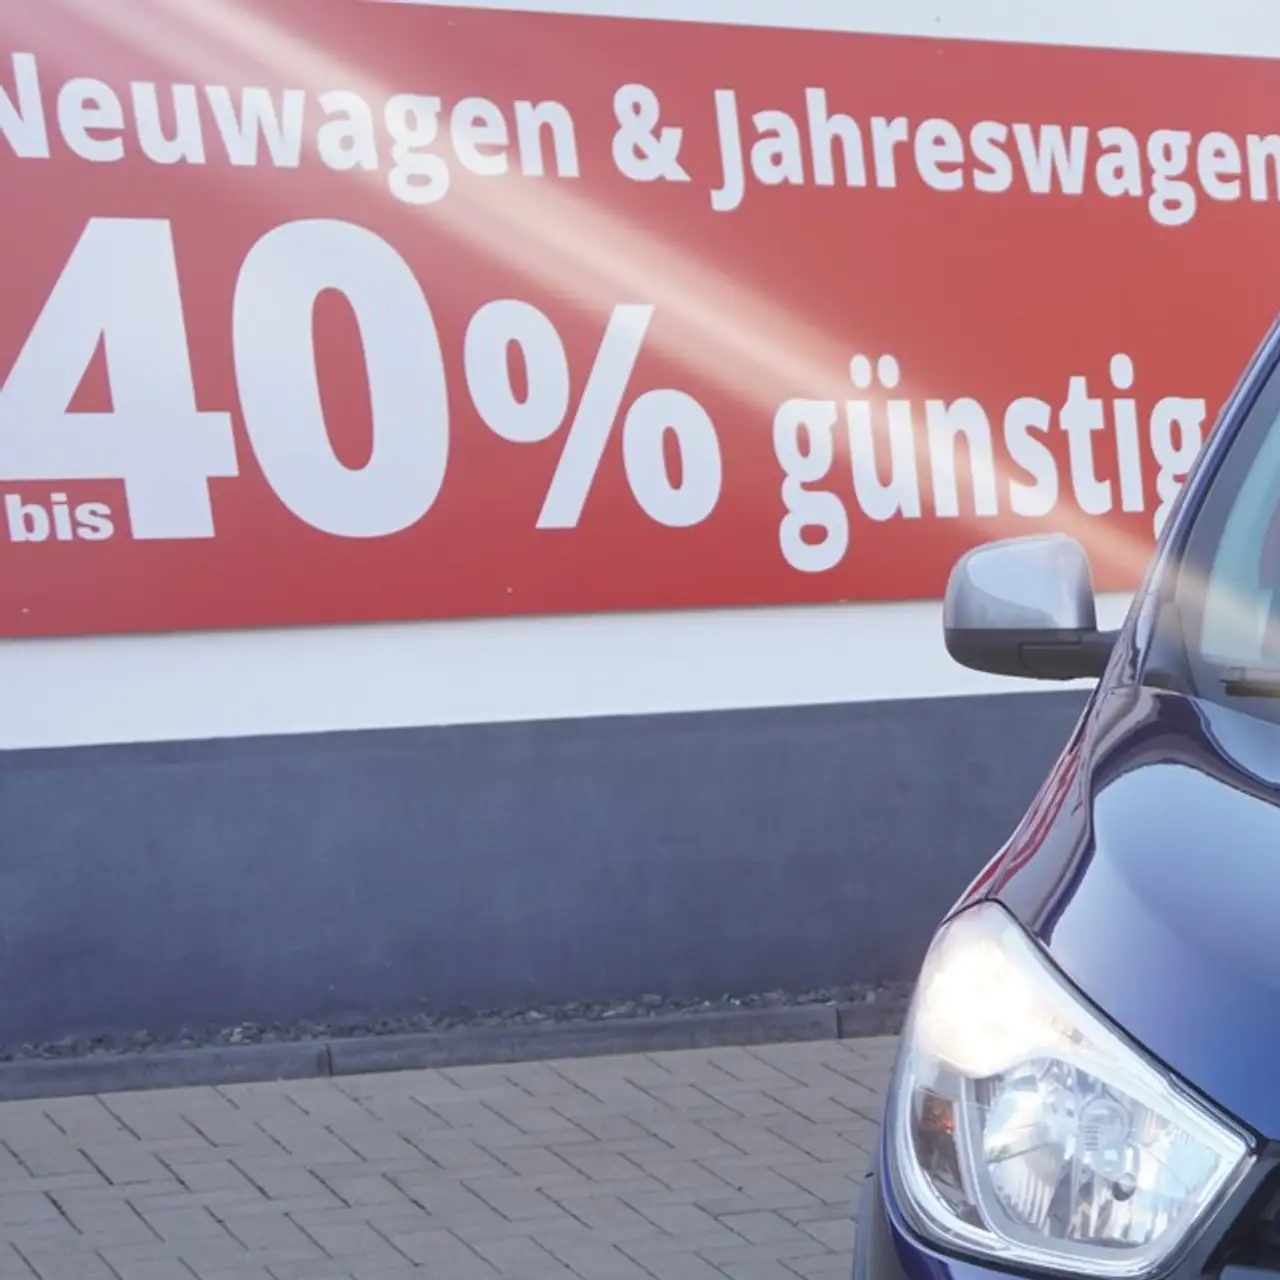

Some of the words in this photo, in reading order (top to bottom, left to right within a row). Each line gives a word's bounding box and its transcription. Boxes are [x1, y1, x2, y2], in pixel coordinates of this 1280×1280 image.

[0, 52, 579, 204] Neuwagen
[610, 83, 692, 184] &
[0, 216, 722, 540] 40%
[772, 353, 1206, 573] günstig
[4, 492, 115, 542] bis
